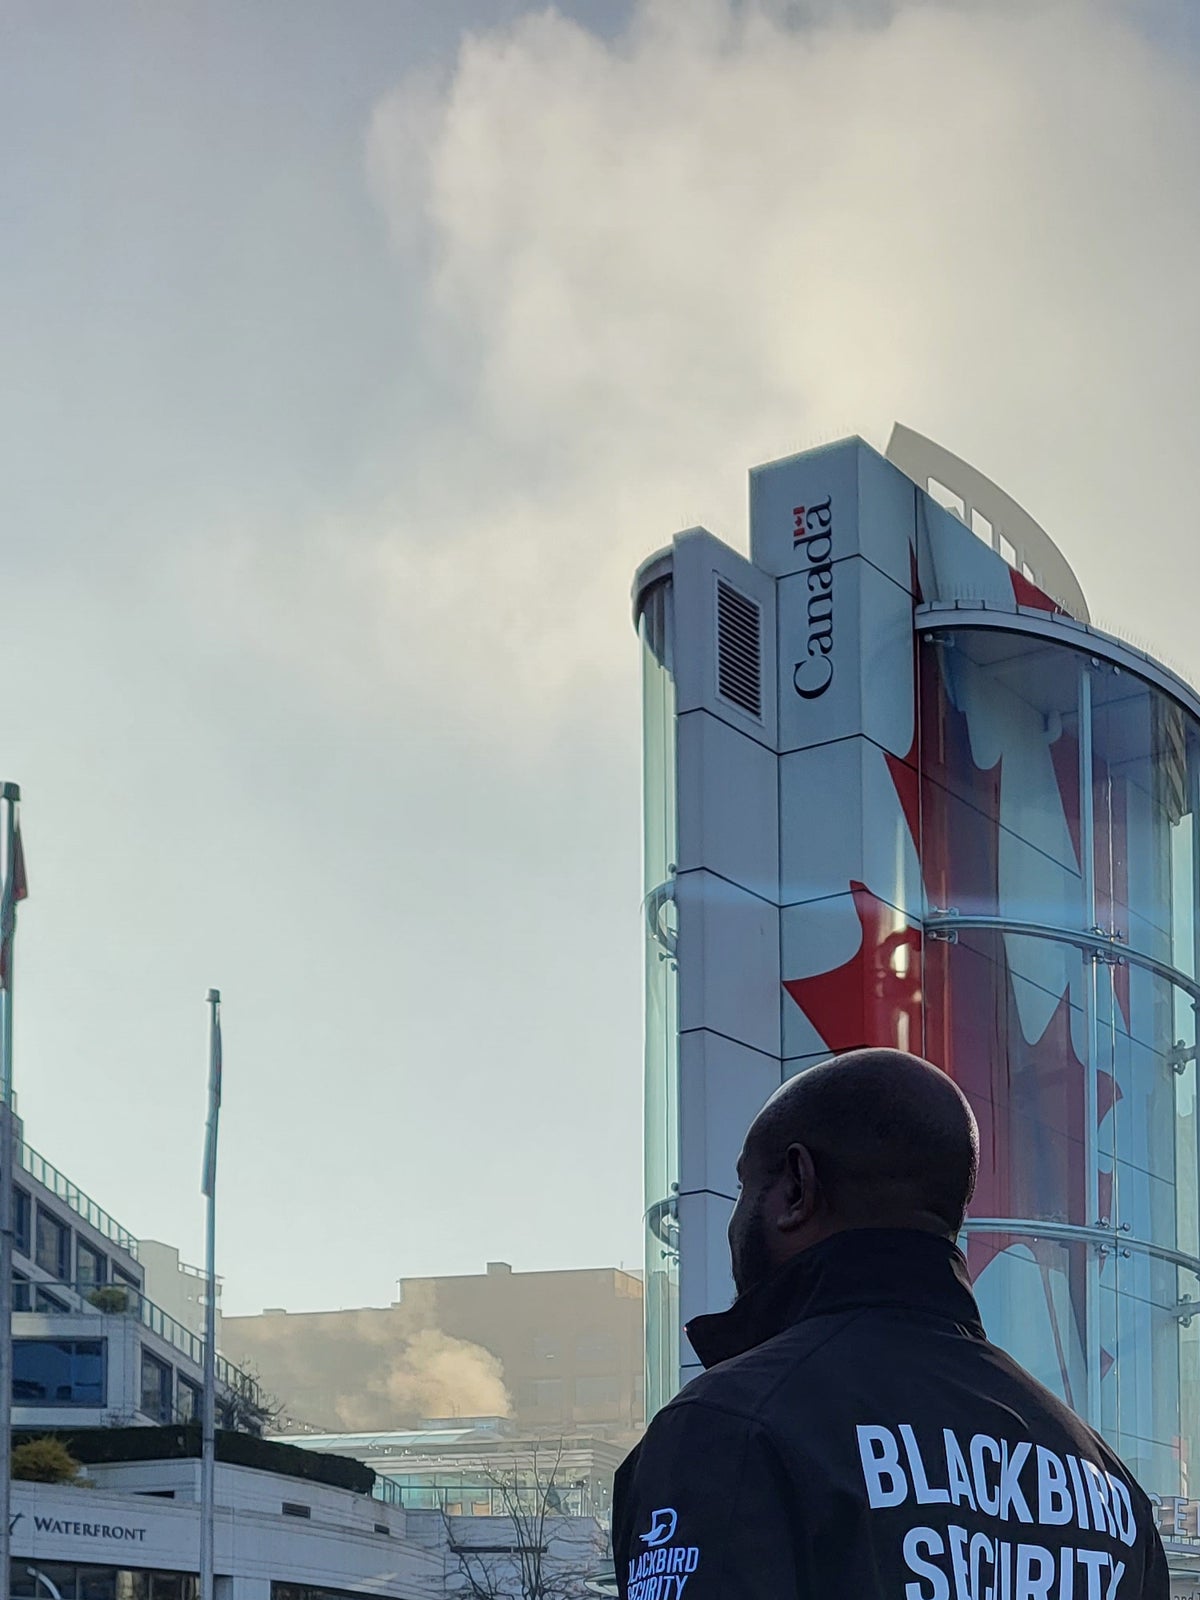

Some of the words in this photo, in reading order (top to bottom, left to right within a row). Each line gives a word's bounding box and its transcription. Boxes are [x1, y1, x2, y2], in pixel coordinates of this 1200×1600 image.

[793, 494, 834, 700] Canada
[855, 1424, 1137, 1548] BLACKBIRD
[33, 1516, 147, 1542] WATERFRONT
[627, 1547, 699, 1585] LACKBIRD
